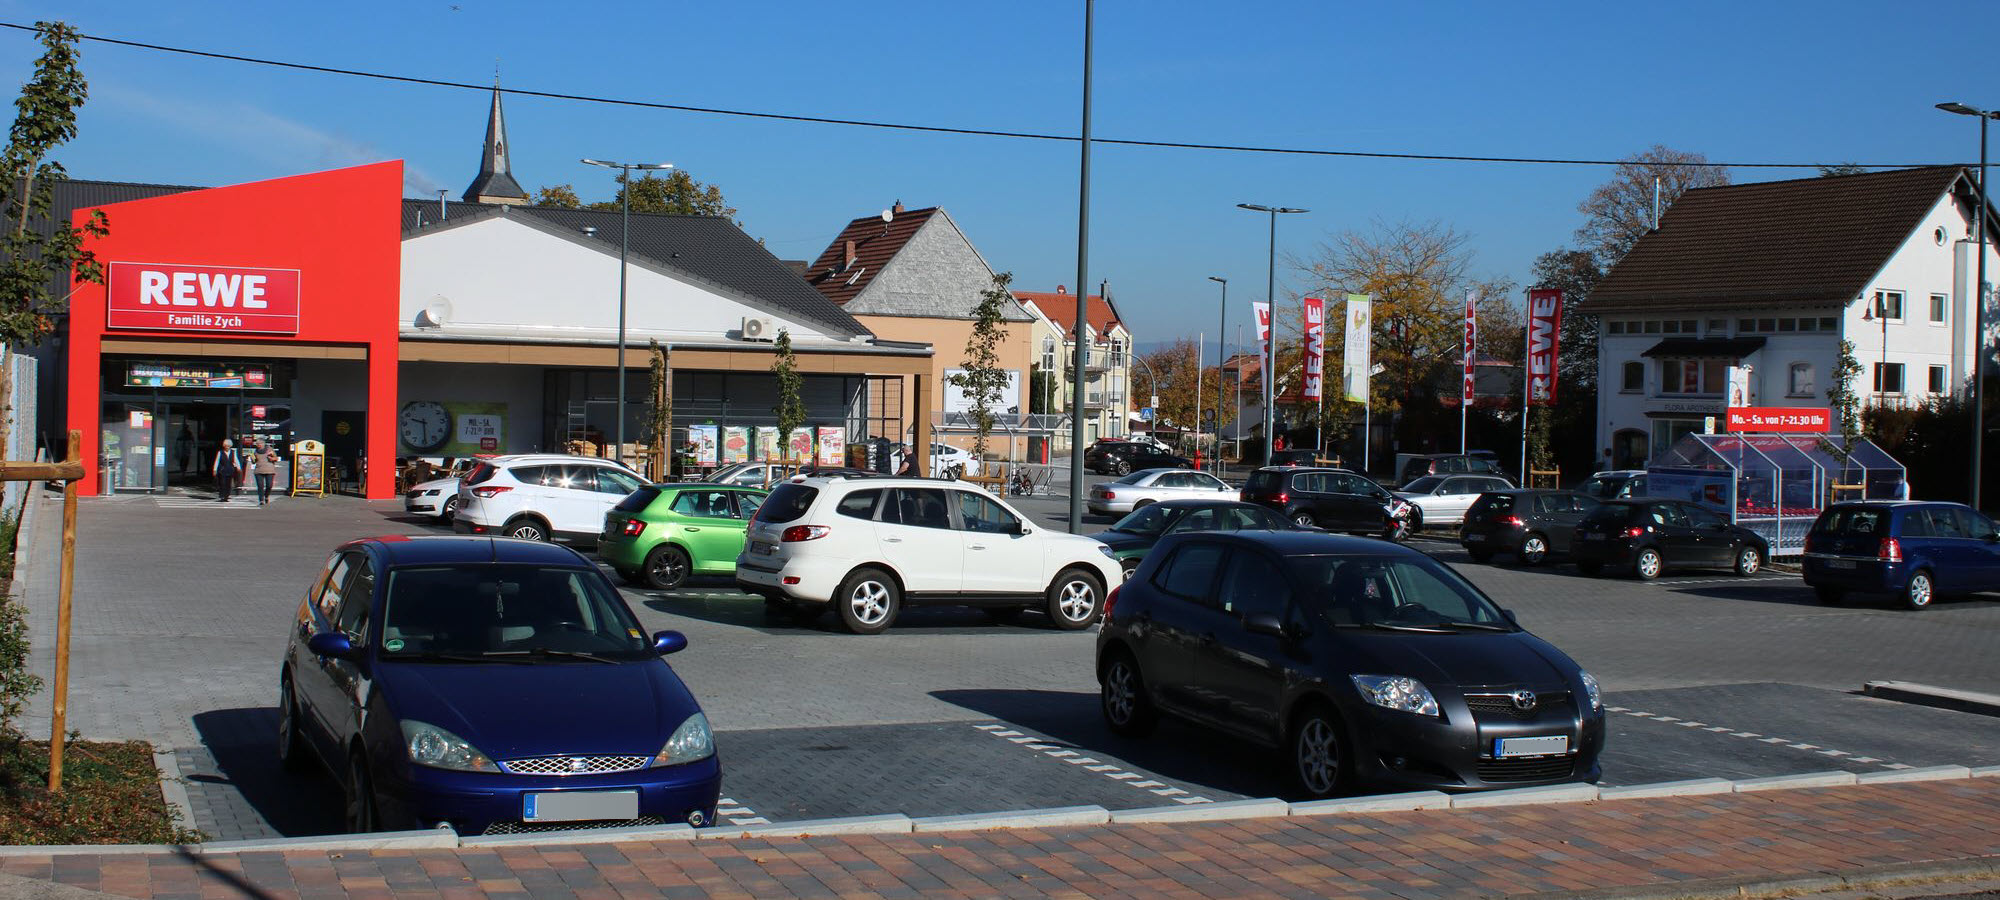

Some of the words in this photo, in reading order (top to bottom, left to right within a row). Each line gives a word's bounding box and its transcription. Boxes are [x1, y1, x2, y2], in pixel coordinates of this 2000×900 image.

[140, 270, 268, 309] REWE
[168, 314, 212, 326] Familie
[214, 315, 242, 328] Zych
[1531, 296, 1556, 400] REWE
[1664, 404, 1685, 412] FLORA
[1731, 415, 1746, 424] Mo.
[1752, 415, 1764, 424] Sa.
[1765, 417, 1779, 425] von
[1811, 415, 1824, 425] Uhr
